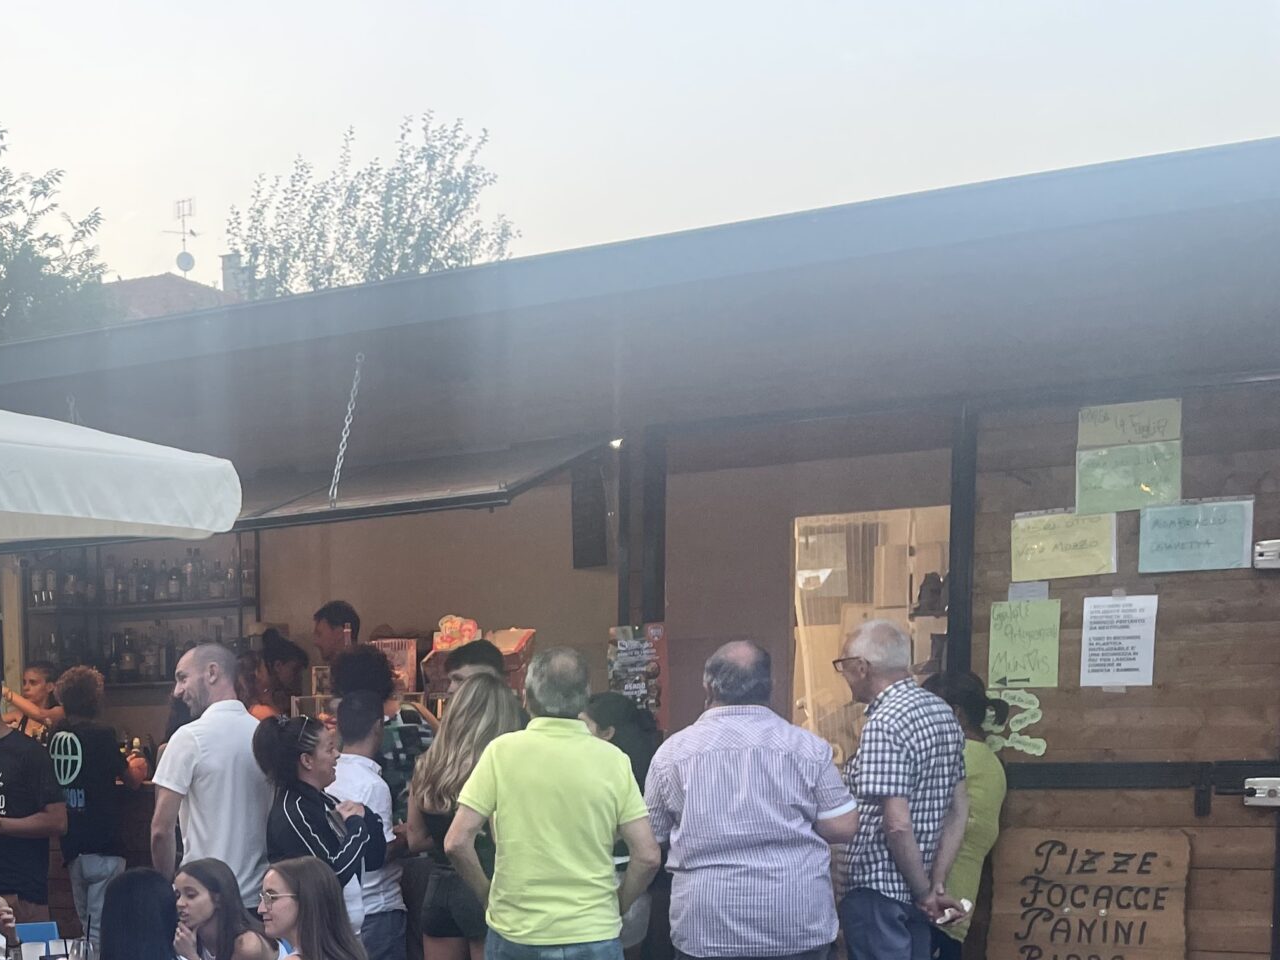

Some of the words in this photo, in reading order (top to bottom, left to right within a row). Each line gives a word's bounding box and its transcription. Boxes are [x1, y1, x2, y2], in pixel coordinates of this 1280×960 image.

[1034, 839, 1159, 875] PIZZE
[1020, 875, 1170, 911] FOCACCE
[1014, 907, 1148, 945] PANINI
